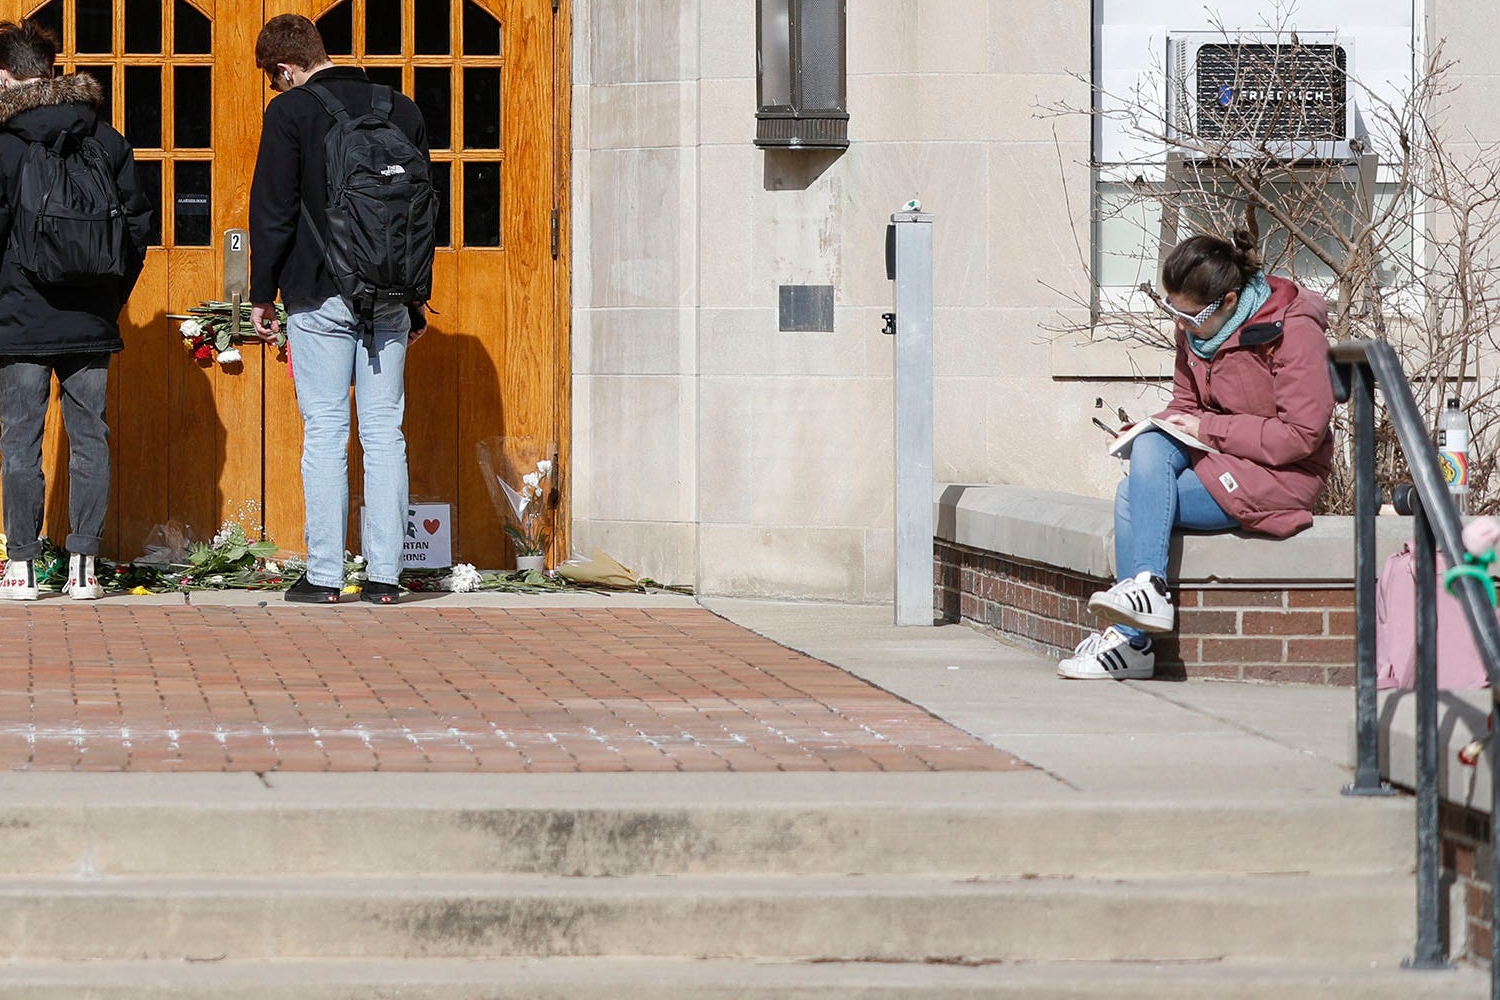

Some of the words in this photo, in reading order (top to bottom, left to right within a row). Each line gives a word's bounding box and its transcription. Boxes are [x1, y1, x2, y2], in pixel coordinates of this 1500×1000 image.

[232, 234, 240, 250] 2
[403, 541, 428, 549] RTAN
[403, 553, 426, 561] ONG
